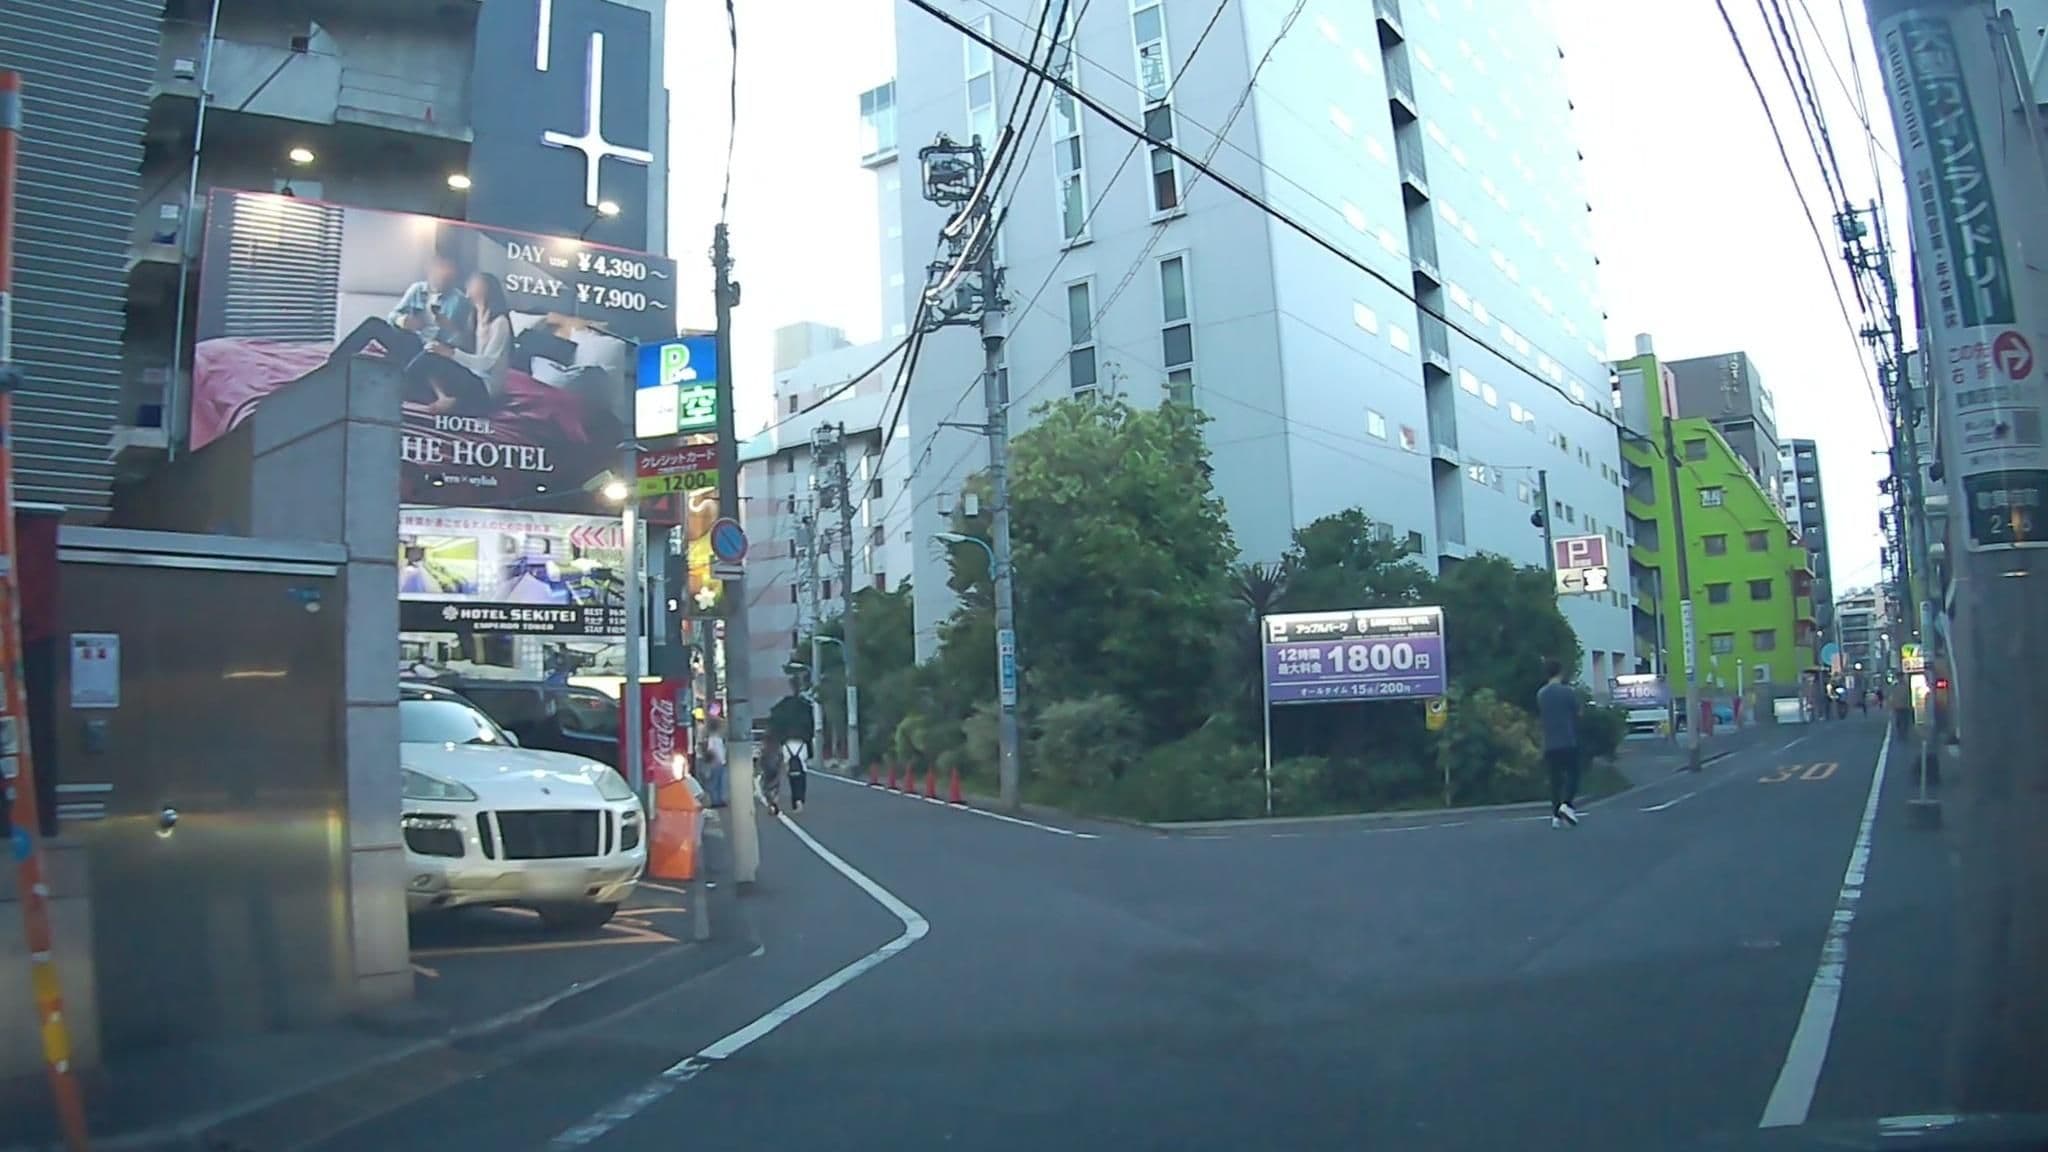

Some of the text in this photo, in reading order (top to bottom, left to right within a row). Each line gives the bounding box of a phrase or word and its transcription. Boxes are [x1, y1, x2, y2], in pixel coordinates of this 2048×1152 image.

[1886, 29, 1925, 150] Laundromat
[507, 242, 545, 263] DAY
[505, 273, 563, 297] STAY
[660, 344, 691, 385] P
[680, 385, 717, 428] 空
[435, 414, 496, 434] HOTEL
[452, 440, 554, 472] HOTEL
[641, 449, 716, 468] クレジットカード
[663, 472, 708, 492] 1200
[1568, 540, 1592, 568] P
[460, 607, 508, 620] HOTEL
[510, 607, 576, 622] SEKITEI
[1295, 622, 1349, 635] アップルパーク
[1277, 642, 1431, 674] 12時間 1800円
[1277, 662, 1323, 676] 最大料金
[1758, 762, 1839, 784] 30
